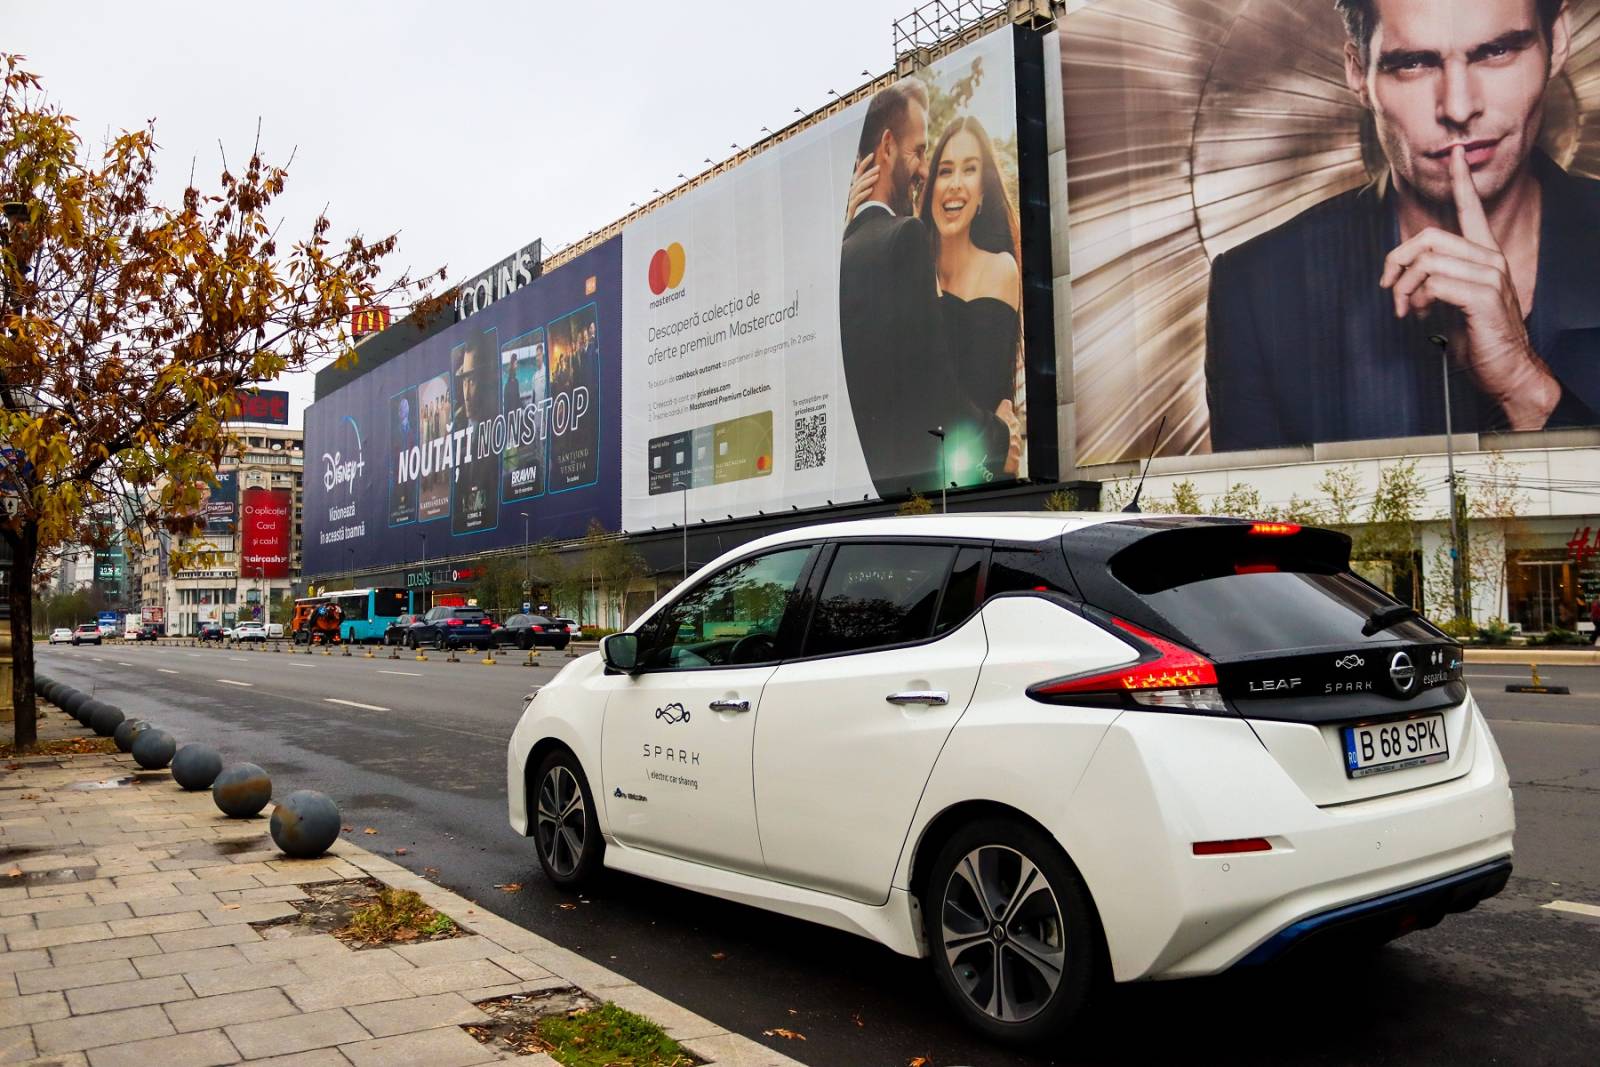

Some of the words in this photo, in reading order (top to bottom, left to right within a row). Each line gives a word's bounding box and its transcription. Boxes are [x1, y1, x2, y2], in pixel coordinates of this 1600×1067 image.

[649, 288, 686, 309] mastercard
[648, 313, 700, 343] Descoperă
[702, 296, 744, 324] colecția
[746, 290, 760, 307] de
[648, 345, 677, 365] oferte
[680, 330, 727, 358] premium
[729, 296, 800, 338] Mastercard!
[676, 368, 699, 381] cashback
[699, 361, 721, 375] automat
[690, 396, 718, 411] Mastercard
[719, 392, 742, 404] Premium
[697, 383, 731, 400] priceless.com
[398, 422, 474, 484] NOUTĂȚI
[477, 385, 590, 460] NONSTOP
[322, 451, 366, 495] Disney+
[511, 465, 537, 485] BRAWN
[245, 505, 254, 515] O
[329, 501, 356, 522] Vizionează
[256, 522, 276, 530] Card
[345, 520, 366, 539] toamnă
[250, 554, 281, 563] aircash
[1249, 677, 1302, 692] LEAF
[1325, 680, 1373, 693] SPARK
[1360, 730, 1375, 761] B
[1380, 725, 1401, 757] 68
[1405, 720, 1441, 754] SPK
[643, 744, 701, 766] SPARK
[651, 770, 669, 783] electric
[670, 774, 678, 784] car
[678, 775, 698, 790] sharing
